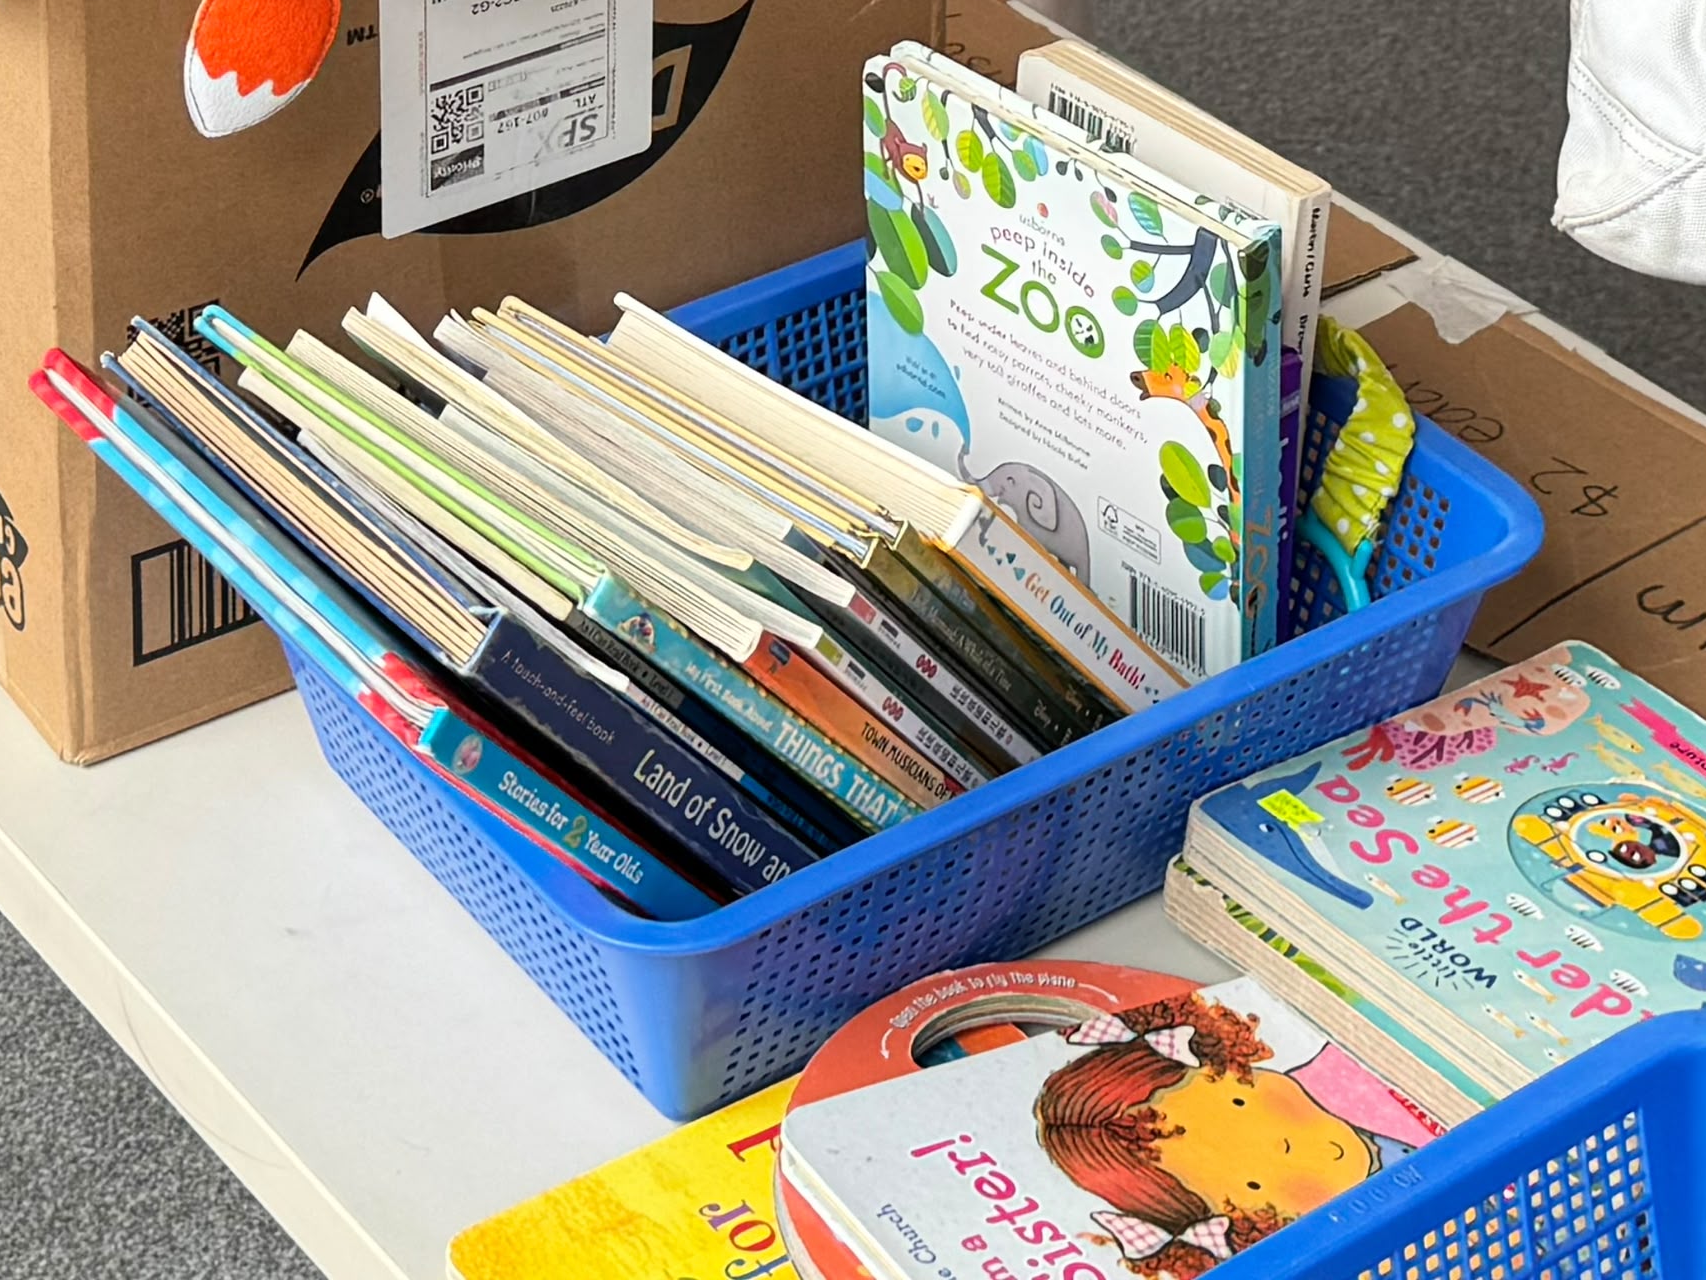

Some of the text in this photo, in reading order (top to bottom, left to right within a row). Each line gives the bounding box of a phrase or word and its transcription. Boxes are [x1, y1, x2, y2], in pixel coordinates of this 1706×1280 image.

[989, 225, 1096, 298] peep inside
[1031, 258, 1058, 286] the
[950, 298, 975, 325] Peep
[1010, 332, 1045, 363] leaves
[1046, 355, 1067, 377] and
[1068, 364, 1109, 400] behind
[1110, 389, 1143, 420] doors
[962, 346, 986, 370] very
[1006, 372, 1048, 405] giraffes
[1049, 396, 1071, 419] and
[1073, 406, 1094, 428] lots
[1095, 424, 1127, 451] more.
[1054, 376, 1094, 413] cheeky
[1095, 400, 1149, 445] monkeys,
[1531, 455, 1622, 519] $2
[1024, 571, 1147, 690] Get Out of My Bath!
[499, 649, 616, 746] A touch-and-feel book
[843, 772, 900, 825] THAT
[861, 721, 890, 754] TOWN
[889, 739, 937, 794] MUSICIANS
[932, 776, 951, 802] OF
[498, 770, 645, 885] Stories for 2 Year Olds
[633, 748, 693, 808] Land
[685, 786, 710, 825] of
[708, 806, 767, 868] Snow
[761, 852, 792, 886] an
[1314, 775, 1420, 866] Sea
[1411, 863, 1513, 946] the
[1399, 915, 1499, 990] WORLD
[914, 990, 936, 1013] the
[935, 979, 967, 1001] book
[1037, 972, 1077, 988] plane
[698, 1199, 792, 1280] for
[875, 1202, 938, 1266] Church
[960, 1233, 989, 1253] a
